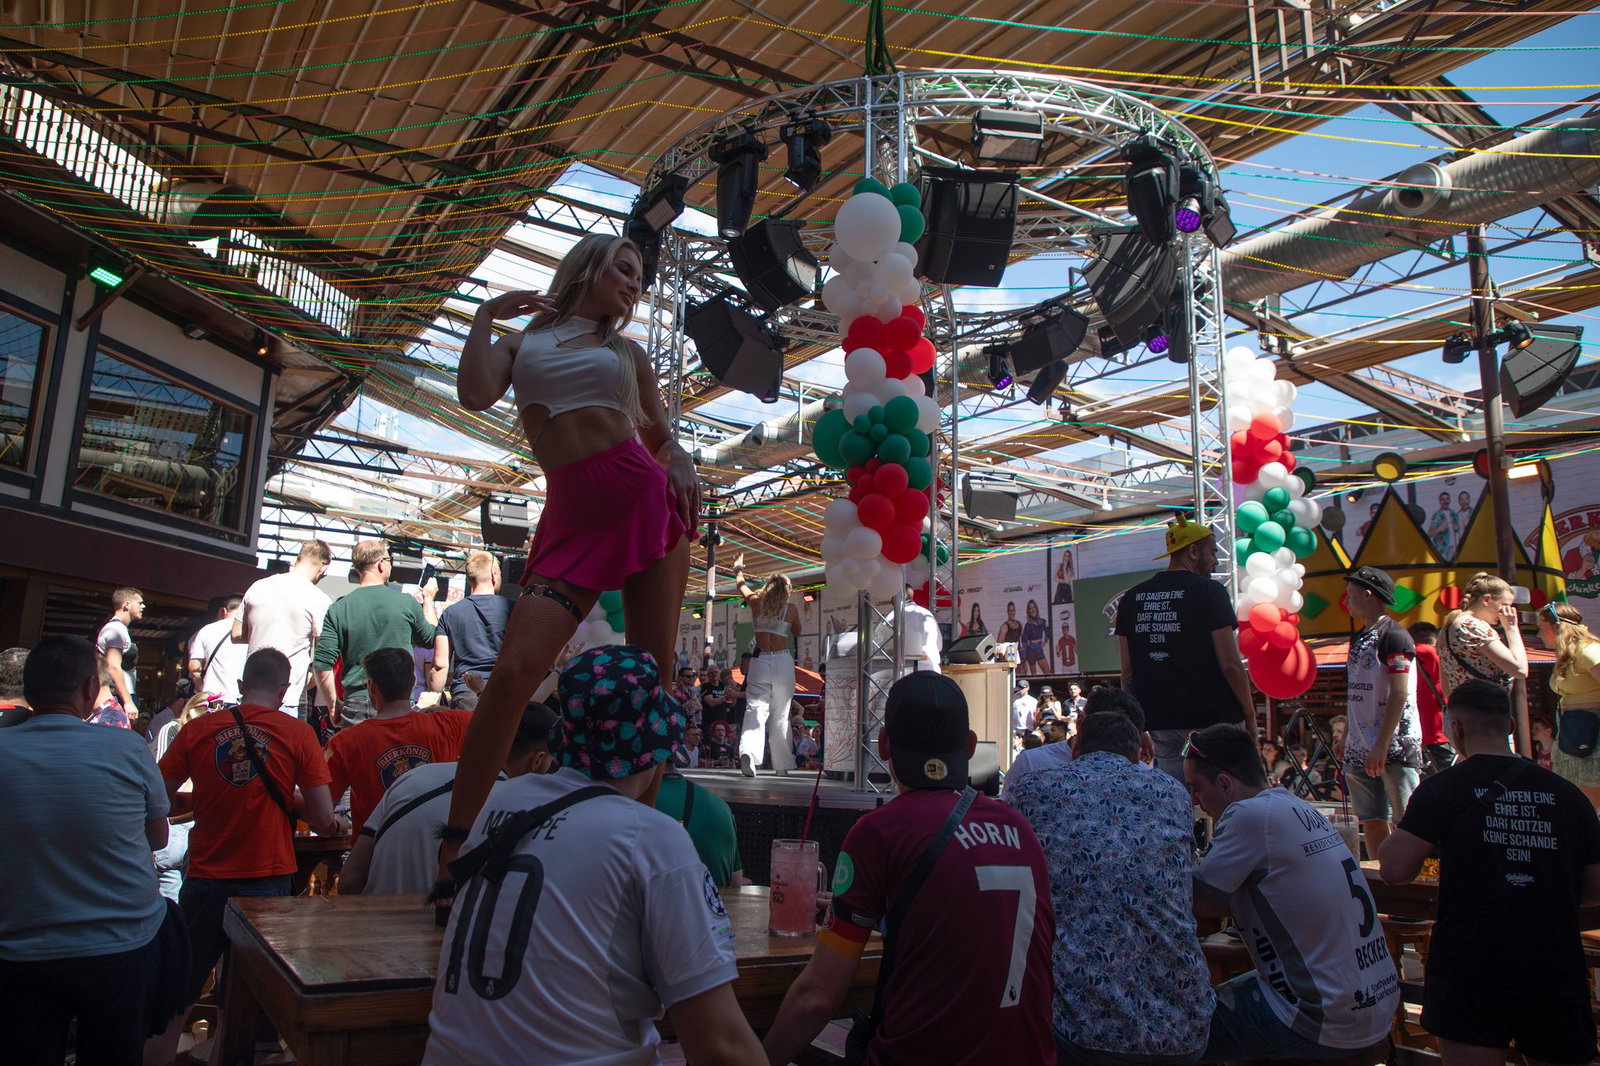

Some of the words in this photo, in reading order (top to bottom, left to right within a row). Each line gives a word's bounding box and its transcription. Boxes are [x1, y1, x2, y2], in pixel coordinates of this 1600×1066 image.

[1146, 591, 1170, 601] SAUFEN
[1170, 590, 1185, 599] EINE
[1144, 601, 1161, 611] EHRE
[1136, 612, 1152, 622] DARF
[1153, 611, 1177, 622] KOTZEN
[1152, 622, 1182, 633] SCHANDE
[379, 746, 428, 766] BIERKÖNIG
[1533, 791, 1557, 806] EINE
[1494, 802, 1519, 817] EHRE
[1510, 819, 1552, 834] KOTZEN
[953, 821, 1022, 850] HORN
[1509, 833, 1559, 850] SCHANDE
[1506, 847, 1531, 862] SEIN!
[1341, 857, 1375, 938] 5
[445, 853, 544, 1001] 10
[975, 865, 1036, 1009] 7
[1355, 936, 1390, 971] BECKER
